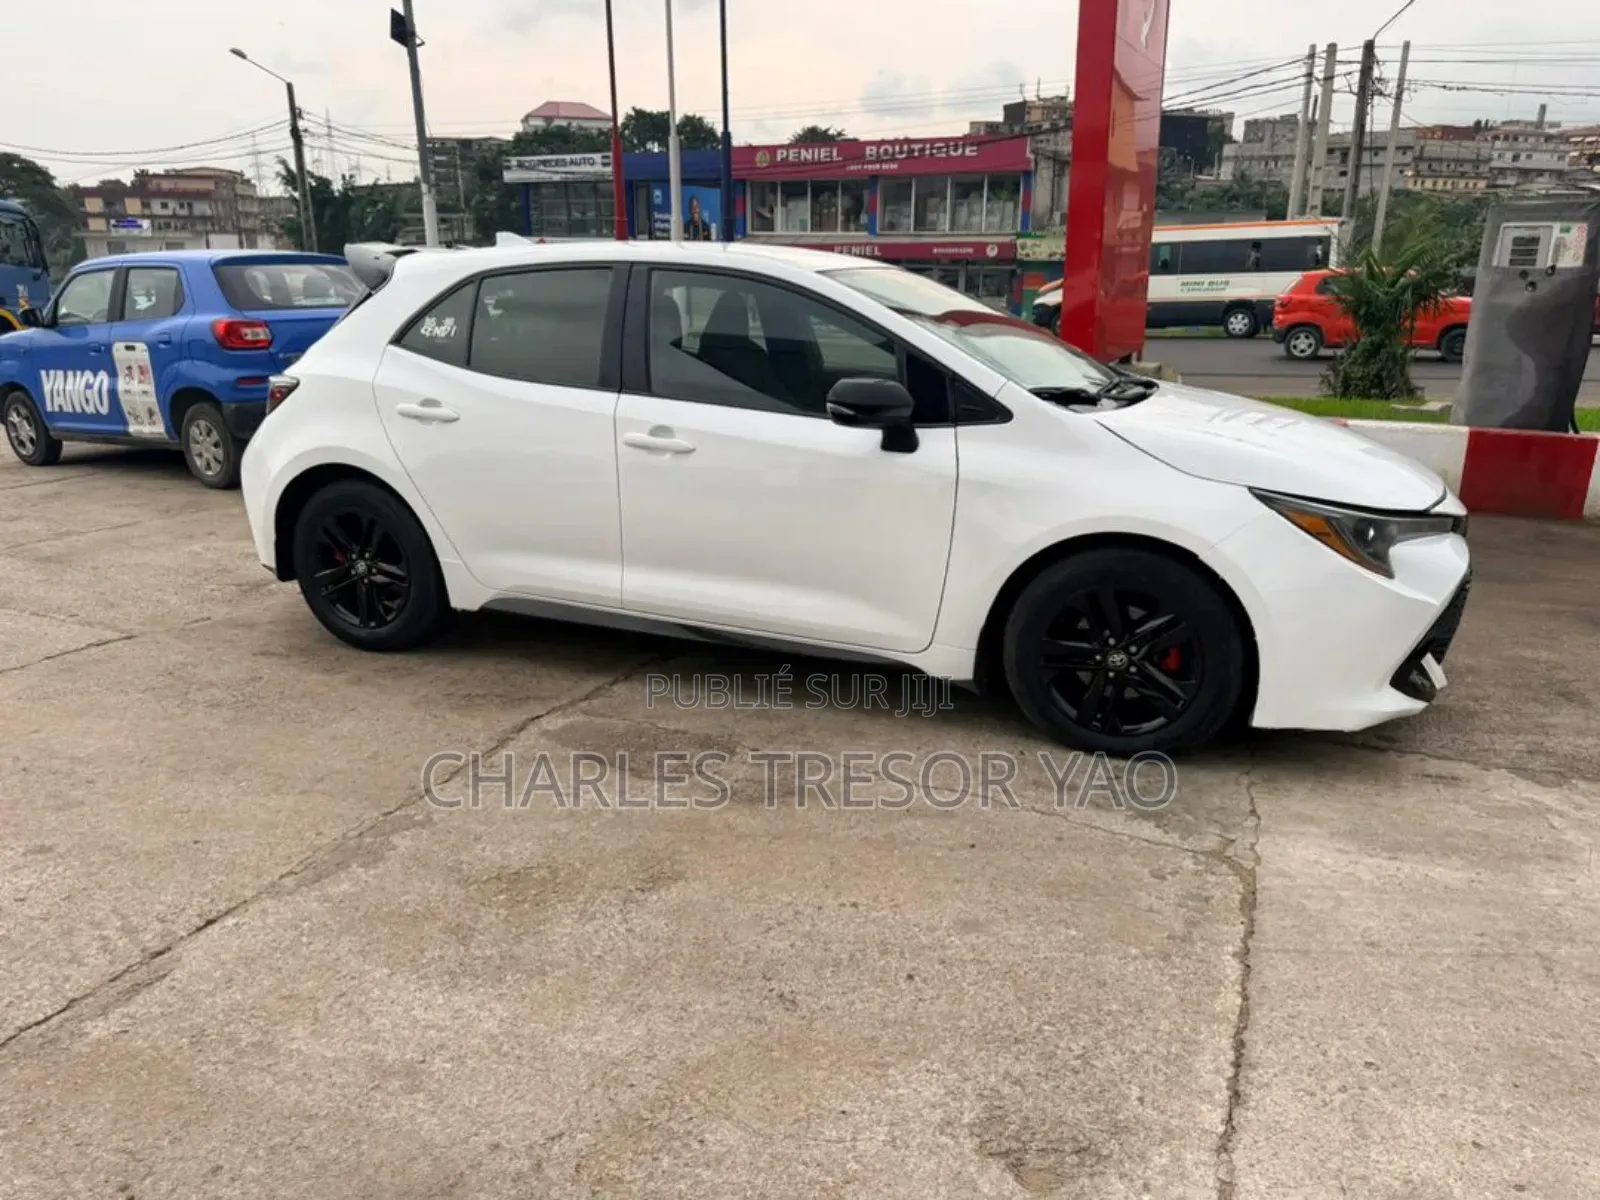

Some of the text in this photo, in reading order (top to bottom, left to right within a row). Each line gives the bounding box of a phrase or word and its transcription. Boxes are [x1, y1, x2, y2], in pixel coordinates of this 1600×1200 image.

[776, 142, 978, 162] PENIEL BOUTIQUE
[569, 157, 595, 166] AUTO
[834, 245, 882, 257] PENIEL
[40, 370, 110, 416] YANGO
